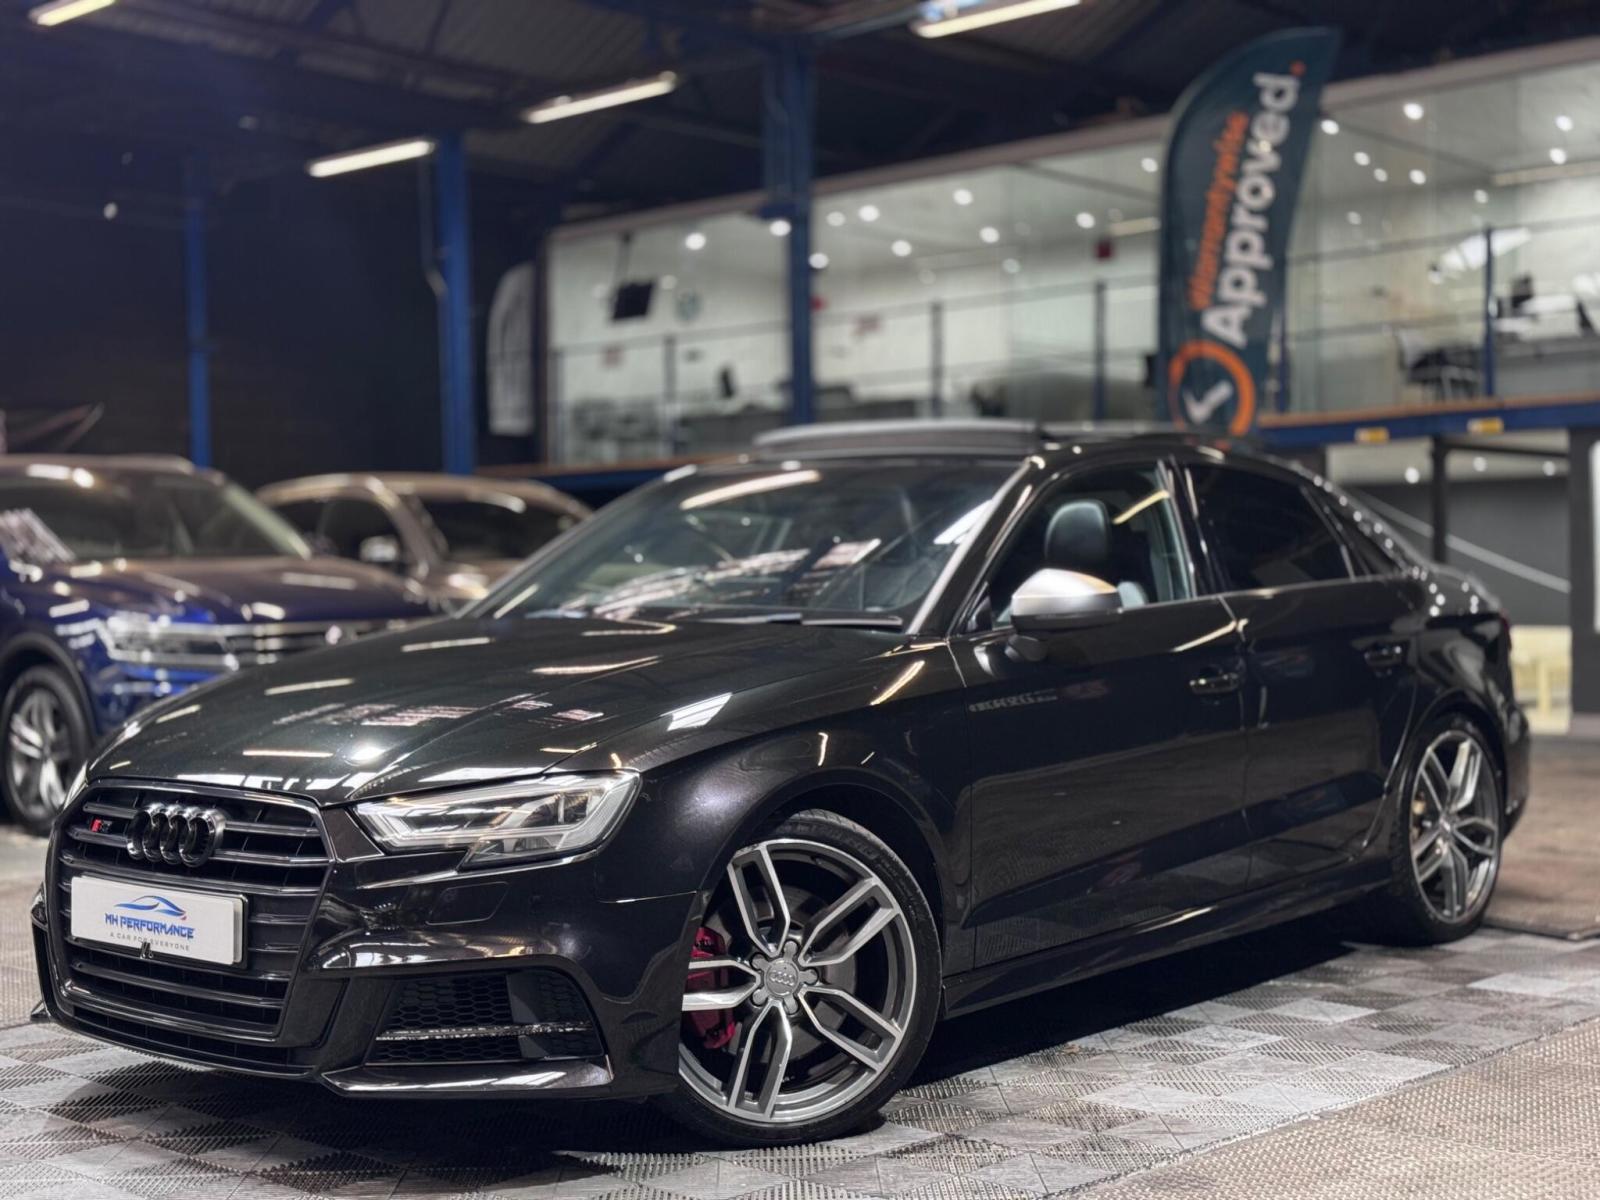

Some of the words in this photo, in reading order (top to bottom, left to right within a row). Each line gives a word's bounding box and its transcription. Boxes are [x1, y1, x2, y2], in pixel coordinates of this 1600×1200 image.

[105, 913, 118, 926] MH
[120, 916, 195, 939] PERFORMANCE
[116, 932, 131, 940] CAR
[151, 938, 190, 951] EVERYONE
